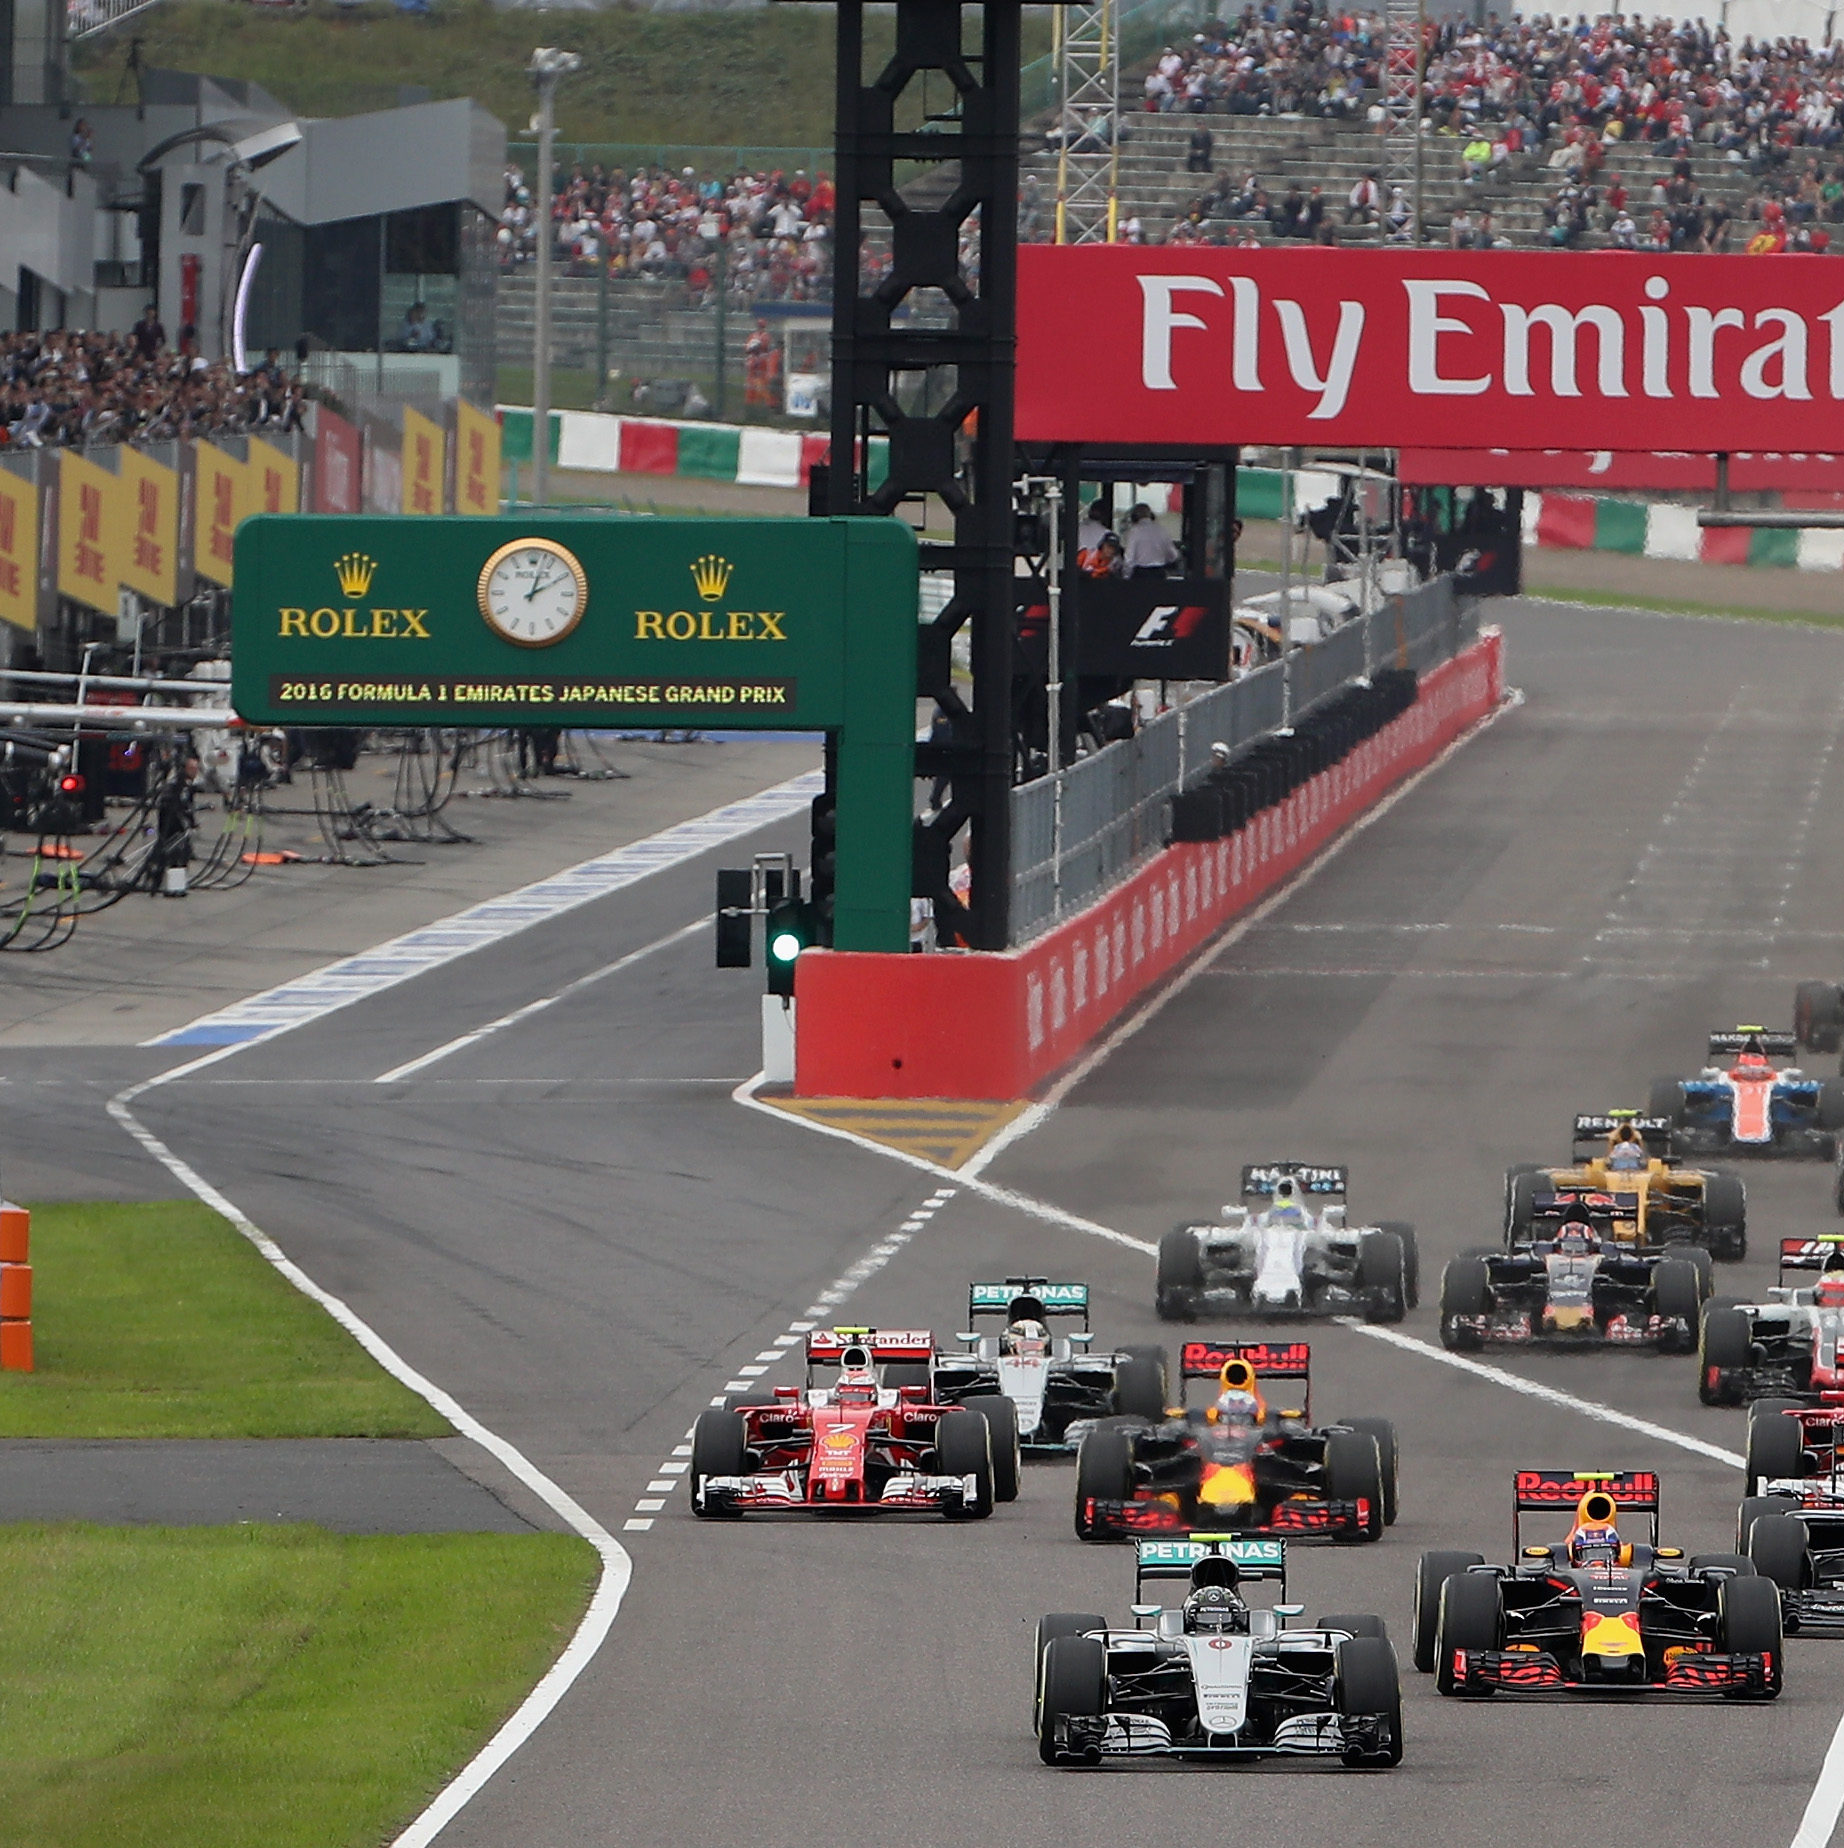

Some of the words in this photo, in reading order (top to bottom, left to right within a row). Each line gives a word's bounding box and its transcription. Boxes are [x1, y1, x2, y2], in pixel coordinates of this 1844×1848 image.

[1137, 275, 1364, 418] Fly
[278, 607, 431, 639] ROLEX
[634, 609, 788, 641] ROLEX
[280, 683, 332, 701] 2016
[337, 683, 432, 702] FORMULA
[437, 684, 449, 702] 1
[453, 684, 555, 703] EMIRATES
[559, 685, 661, 704] JAPANESE
[664, 686, 736, 704] GRAND
[739, 687, 787, 704] PRIX
[1576, 1116, 1668, 1130] RENULT
[1250, 1166, 1342, 1182] MATINI
[760, 1411, 795, 1423] Claro
[903, 1411, 938, 1423] Claro
[1806, 1416, 1841, 1428] Claro
[826, 1422, 856, 1434] 7
[1141, 1541, 1280, 1559] PETRONAS
